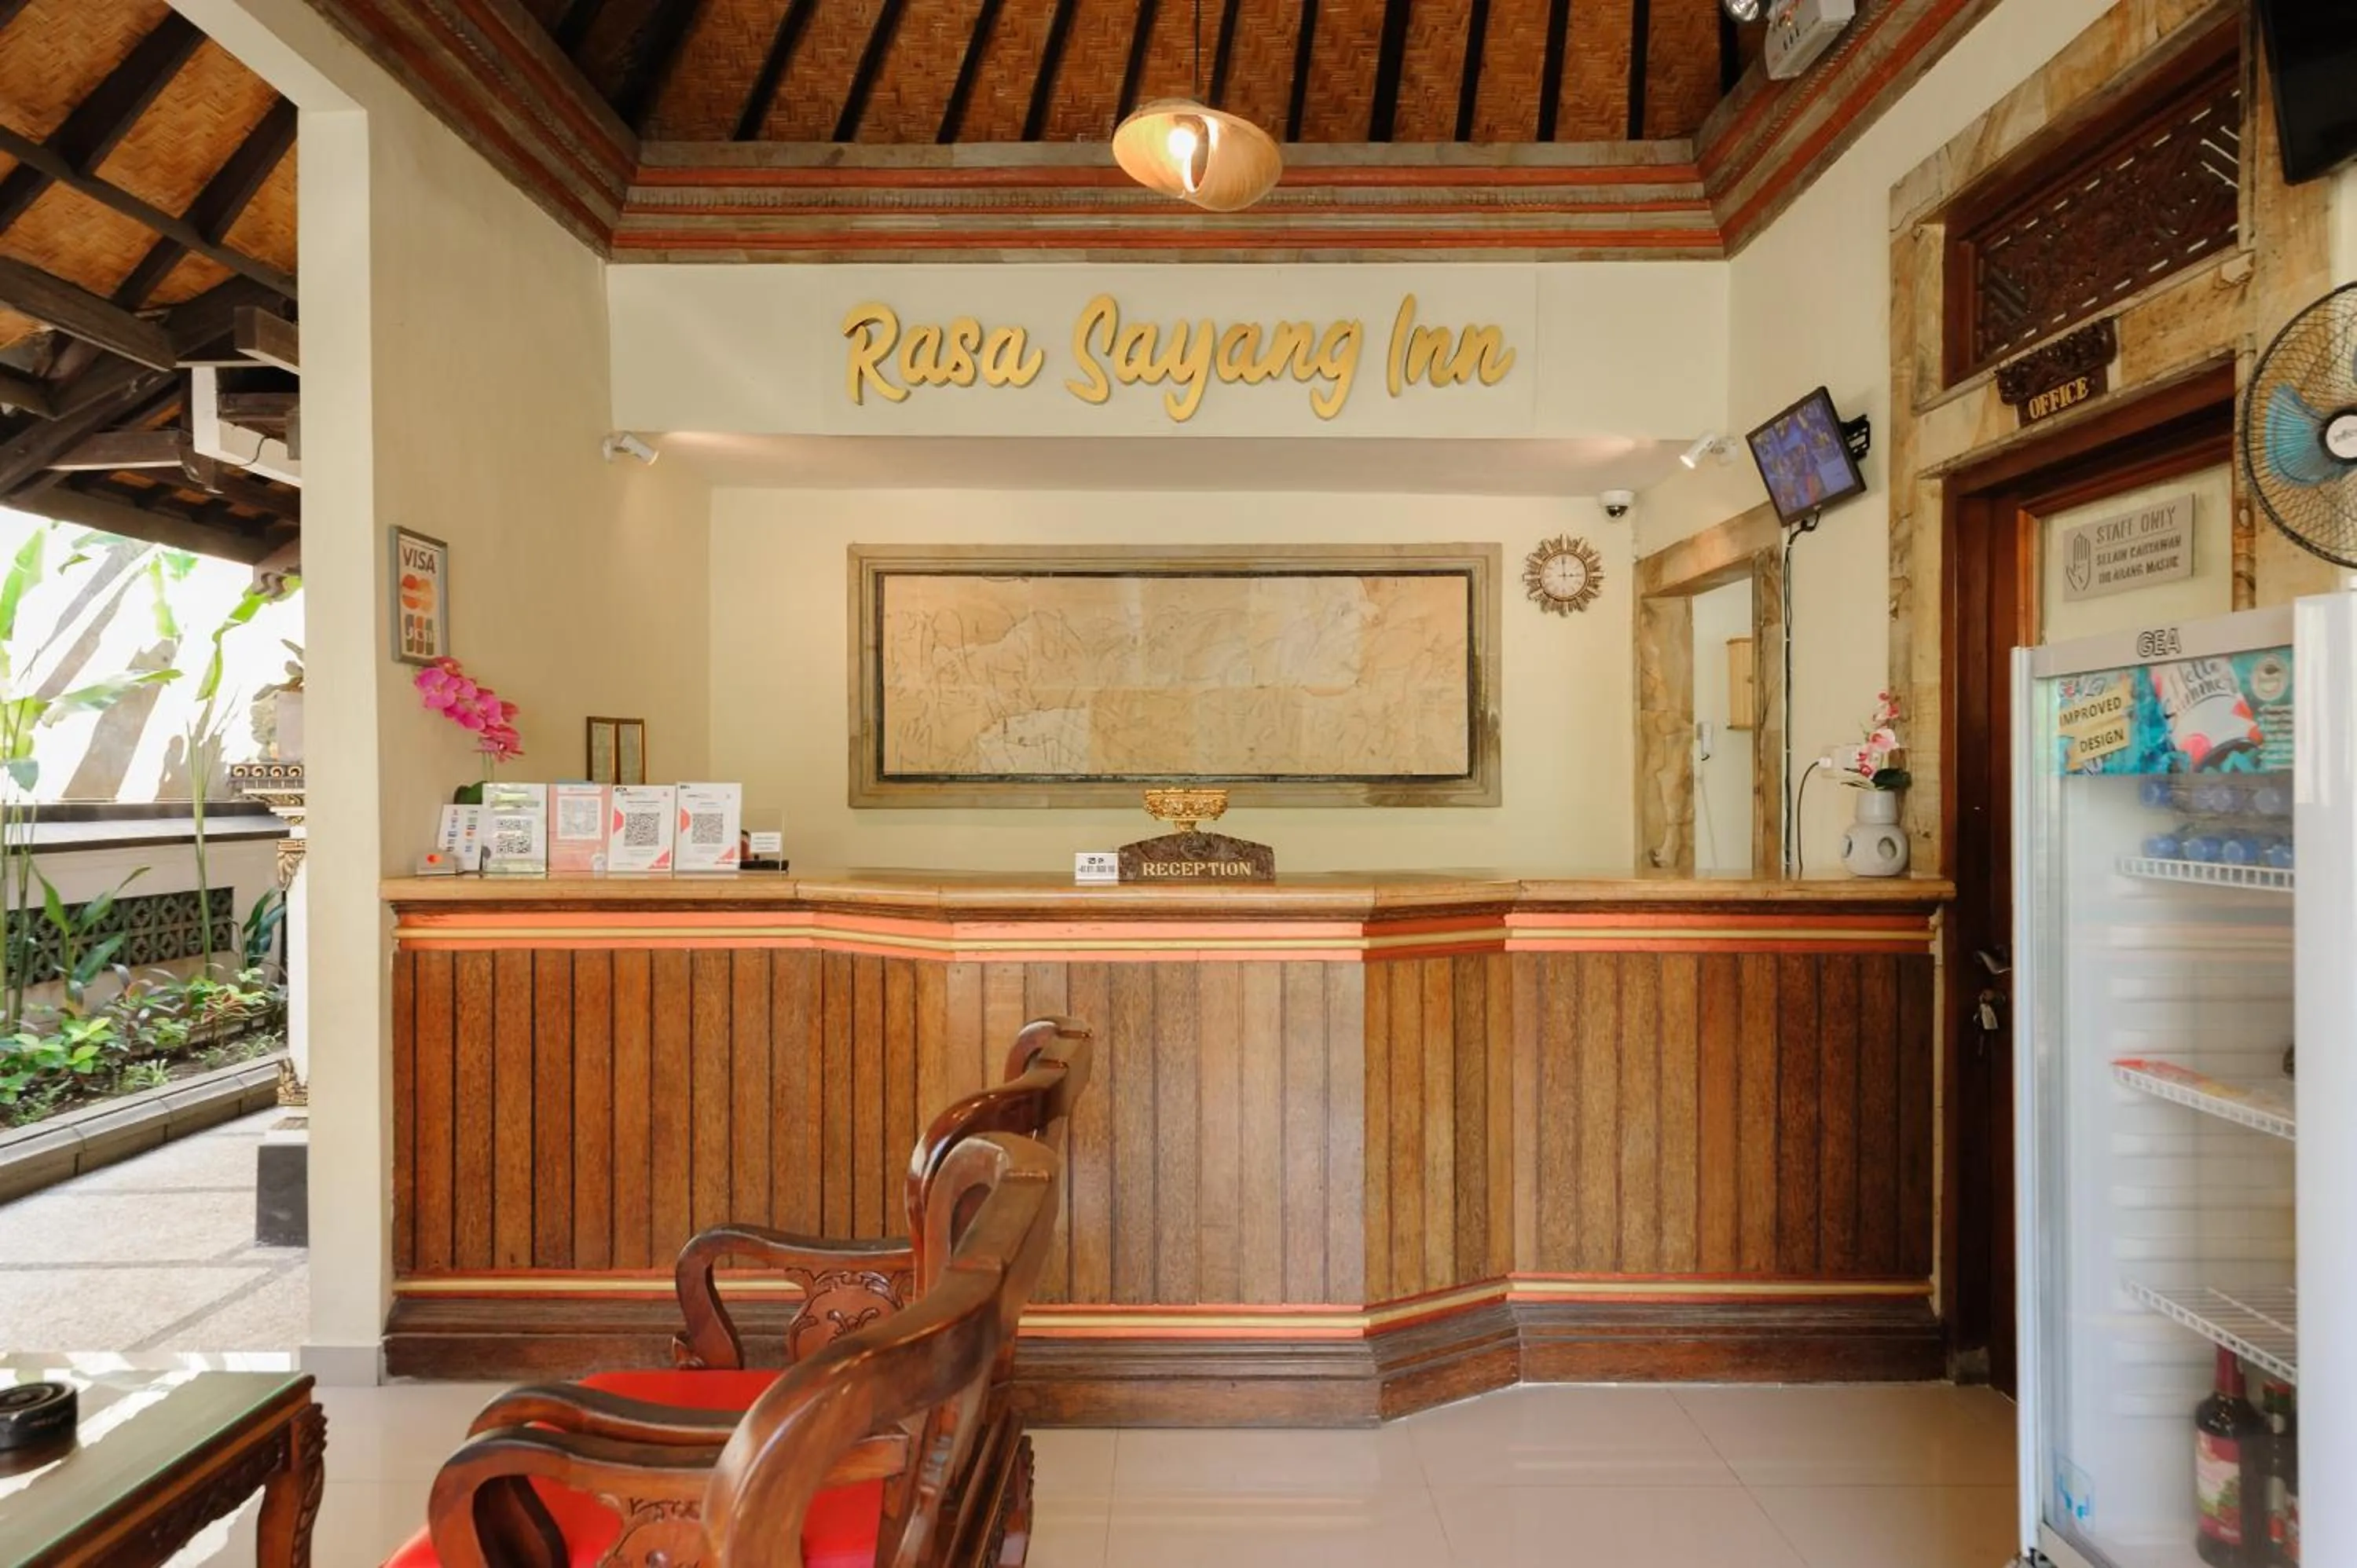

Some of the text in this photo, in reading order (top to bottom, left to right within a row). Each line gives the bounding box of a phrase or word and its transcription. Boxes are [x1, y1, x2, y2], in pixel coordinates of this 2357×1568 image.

[843, 292, 1517, 421] Rasa Sayang Inn
[2029, 377, 2089, 419] OFFICE
[2096, 505, 2176, 544] STAFF ONLY
[401, 545, 436, 574] VISA
[2135, 628, 2182, 658] GEA
[2059, 697, 2121, 726] IMPROVED
[2080, 729, 2124, 753] DESIGN
[1142, 861, 1252, 876] RECEPTION
